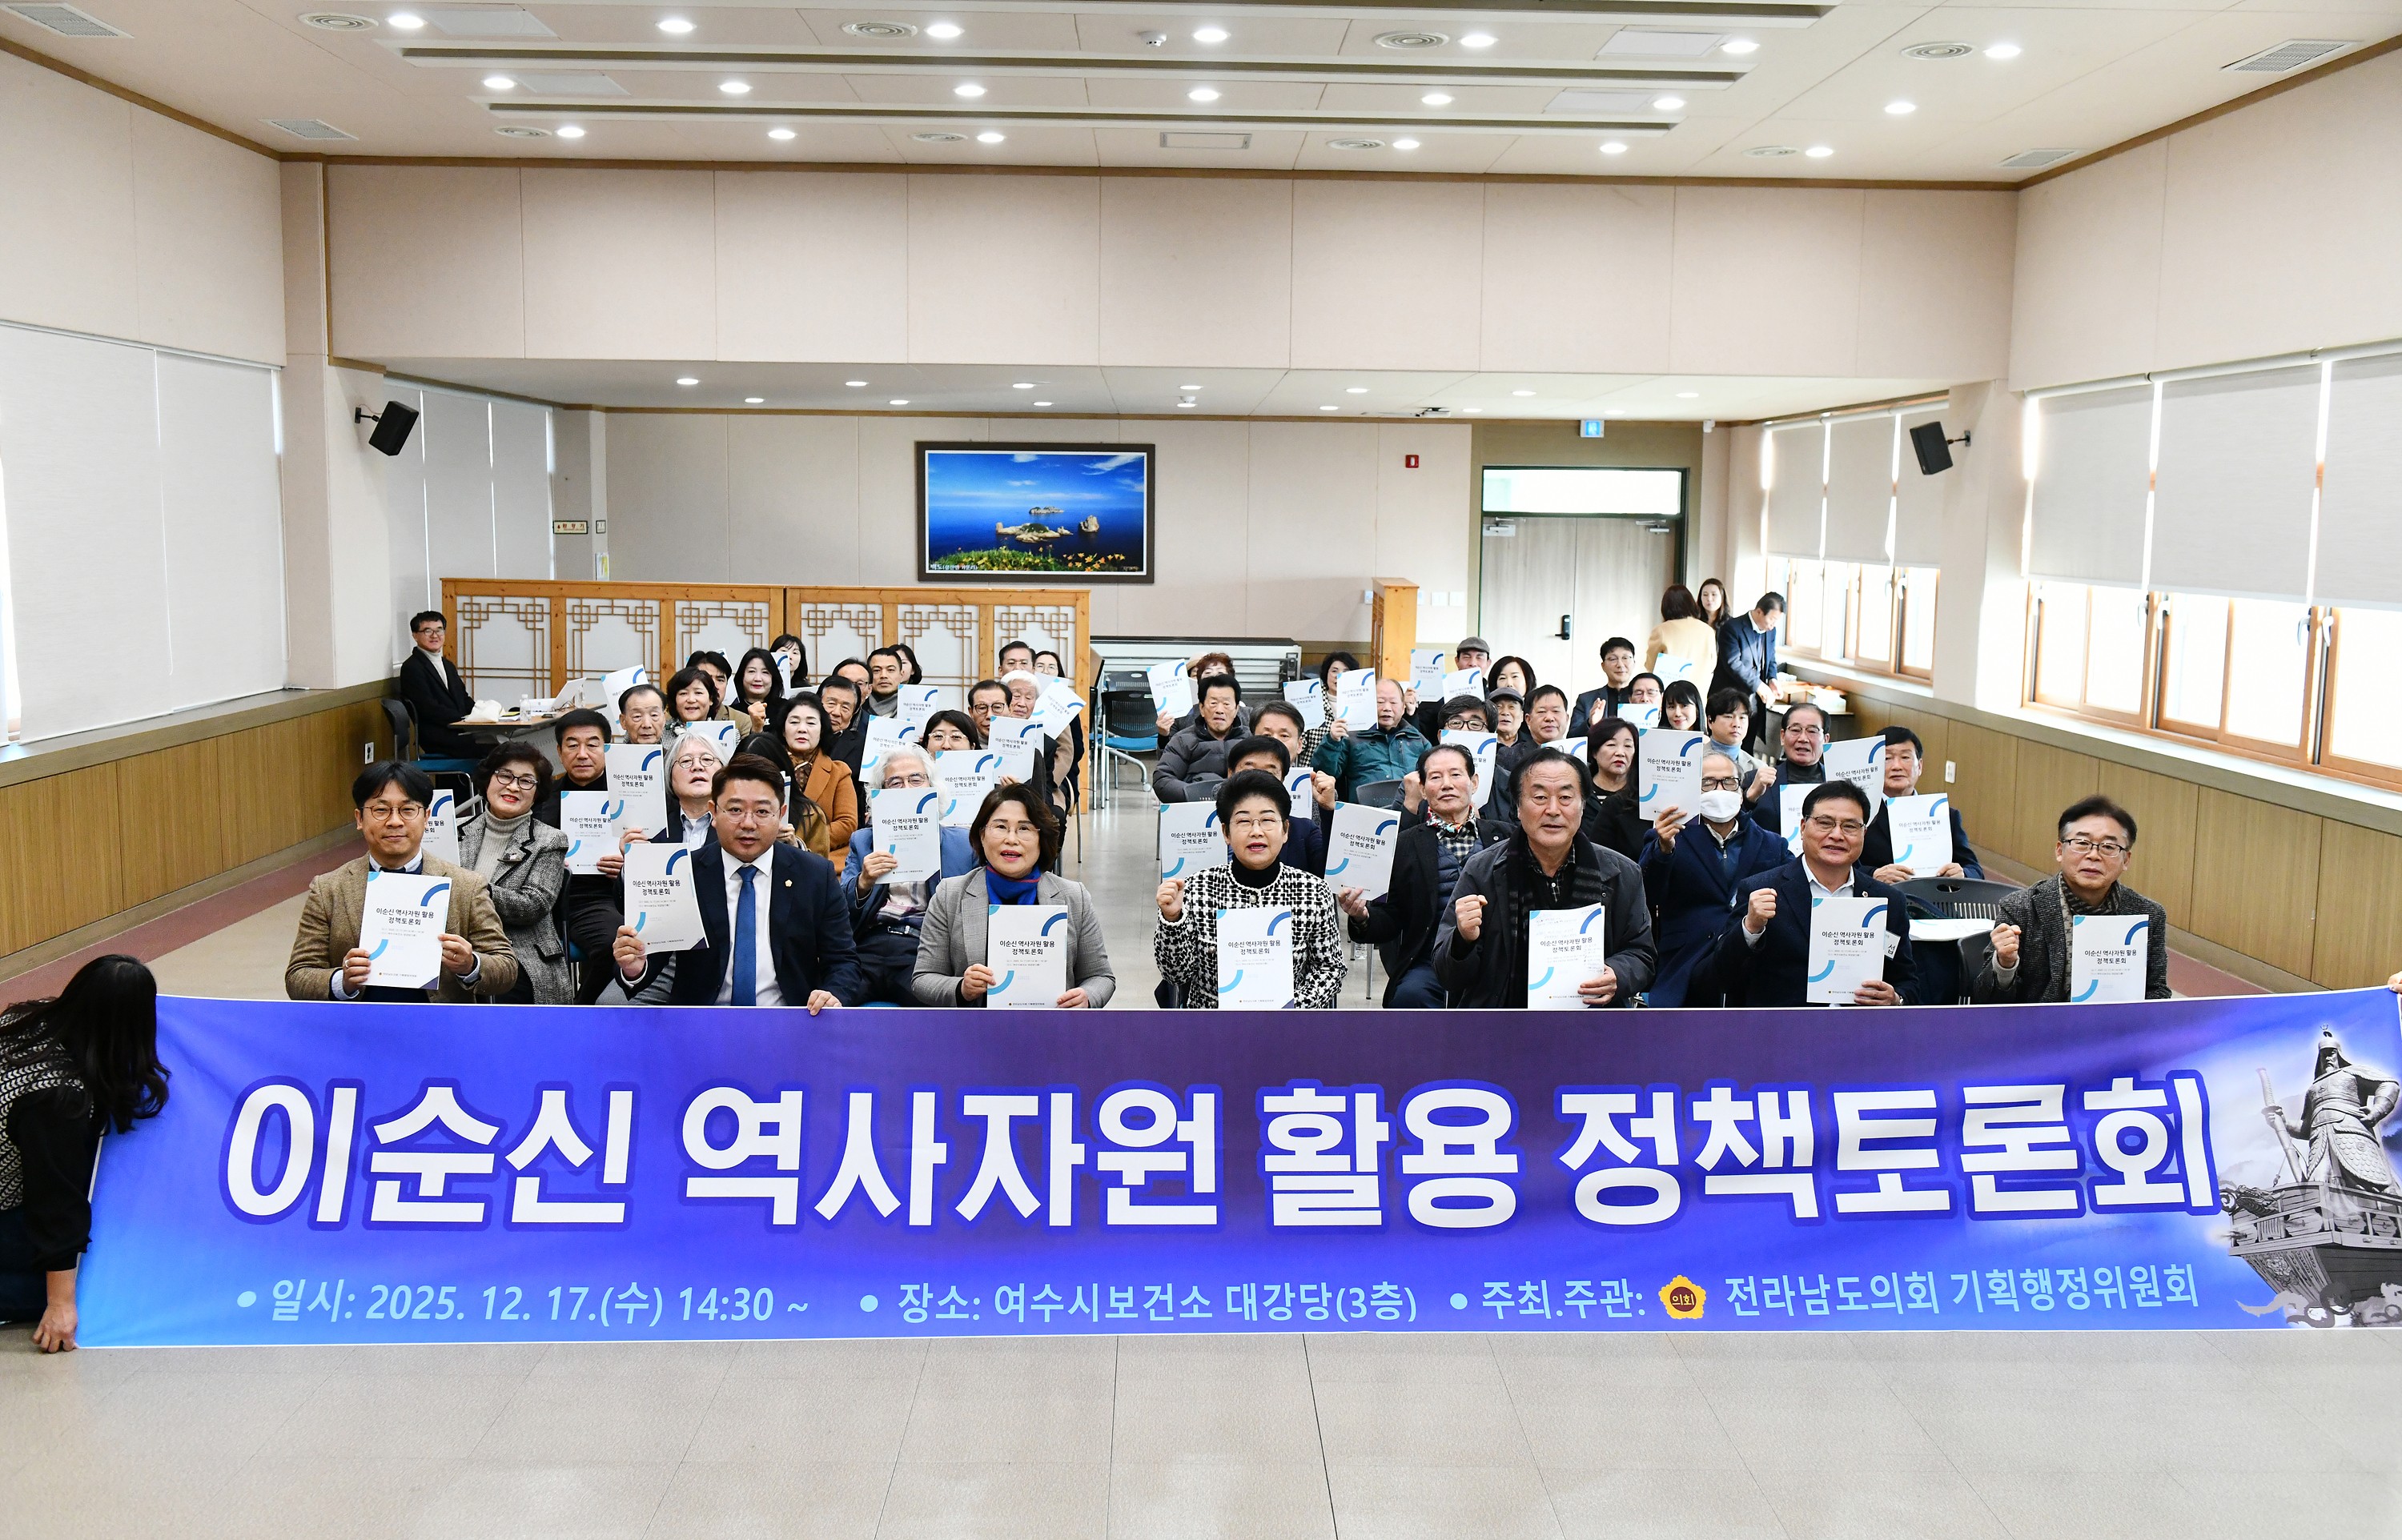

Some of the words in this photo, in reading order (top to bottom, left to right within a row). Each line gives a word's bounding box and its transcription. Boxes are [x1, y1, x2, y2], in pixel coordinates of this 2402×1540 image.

[1648, 758, 1661, 766] 이순신
[1661, 759, 1681, 768] 역사자원
[1656, 765, 1682, 773] 정책토론회
[1836, 770, 1850, 779] 이순신
[1850, 768, 1870, 777] 역사자원
[1909, 826, 1934, 834] 정책토론회
[1340, 832, 1356, 840] 이순신
[1356, 835, 1375, 844] 역사자원
[1376, 837, 1386, 846] 활용
[1350, 840, 1376, 851] 정책토론회
[633, 880, 646, 888] 이순신
[646, 879, 668, 888] 역사자원
[669, 878, 681, 888] 활용
[642, 887, 670, 896] 정책토론회
[376, 908, 395, 916] 이순신
[396, 908, 420, 918] 역사자원
[422, 910, 434, 919] 활용
[388, 917, 421, 925] 정책토론회
[1822, 931, 1839, 939] 이순신
[1839, 931, 1863, 939] 역사자원
[1863, 931, 1875, 939] 활용
[1043, 940, 1055, 948] 활용
[1269, 939, 1281, 947] 활용
[1833, 938, 1864, 946] 정책토론회
[1240, 947, 1270, 955] 정책토론회
[1552, 945, 1582, 953] 정책토론회
[2096, 957, 2127, 965] 정책토론회
[228, 1085, 633, 1222] 이순신
[683, 1087, 1216, 1225] 역사자원
[1264, 1089, 1518, 1227] 활용
[1559, 1077, 2215, 1226] 정책토론회
[1483, 1279, 1645, 1319] 주최.주관:
[1725, 1272, 1939, 1316] 전라남도의회
[1950, 1264, 2198, 1313] 기획행정위원회
[272, 1279, 355, 1322] 일시:
[366, 1285, 464, 1320] 2025.
[483, 1286, 530, 1320] 12.
[548, 1282, 662, 1326] 17.(수)
[680, 1287, 773, 1321] 14:30
[898, 1283, 980, 1323] 장소:
[995, 1283, 1212, 1322] 여수시보건소
[1226, 1283, 1417, 1324] 대강당(3층)
[1672, 1293, 1695, 1305] 의회
